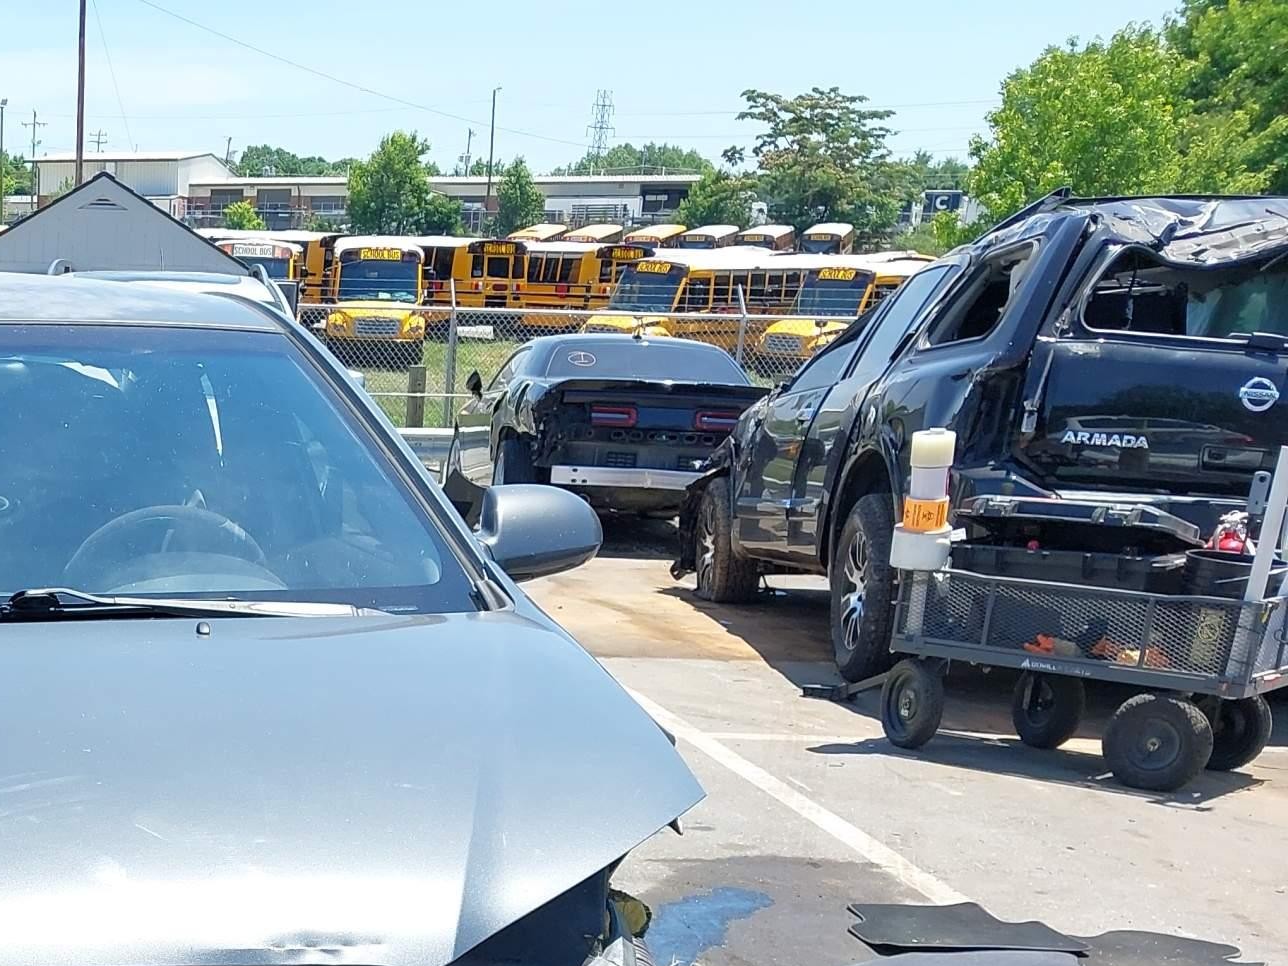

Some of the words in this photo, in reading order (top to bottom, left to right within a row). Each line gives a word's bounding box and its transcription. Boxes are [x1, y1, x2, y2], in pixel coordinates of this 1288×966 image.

[935, 195, 949, 210] C
[234, 246, 258, 256] SCHOOL
[259, 247, 273, 256] BUS
[362, 248, 386, 259] SCHOOL
[387, 249, 400, 259] BUS
[1242, 389, 1278, 400] NISSAN
[1061, 430, 1149, 449] ARMADA
